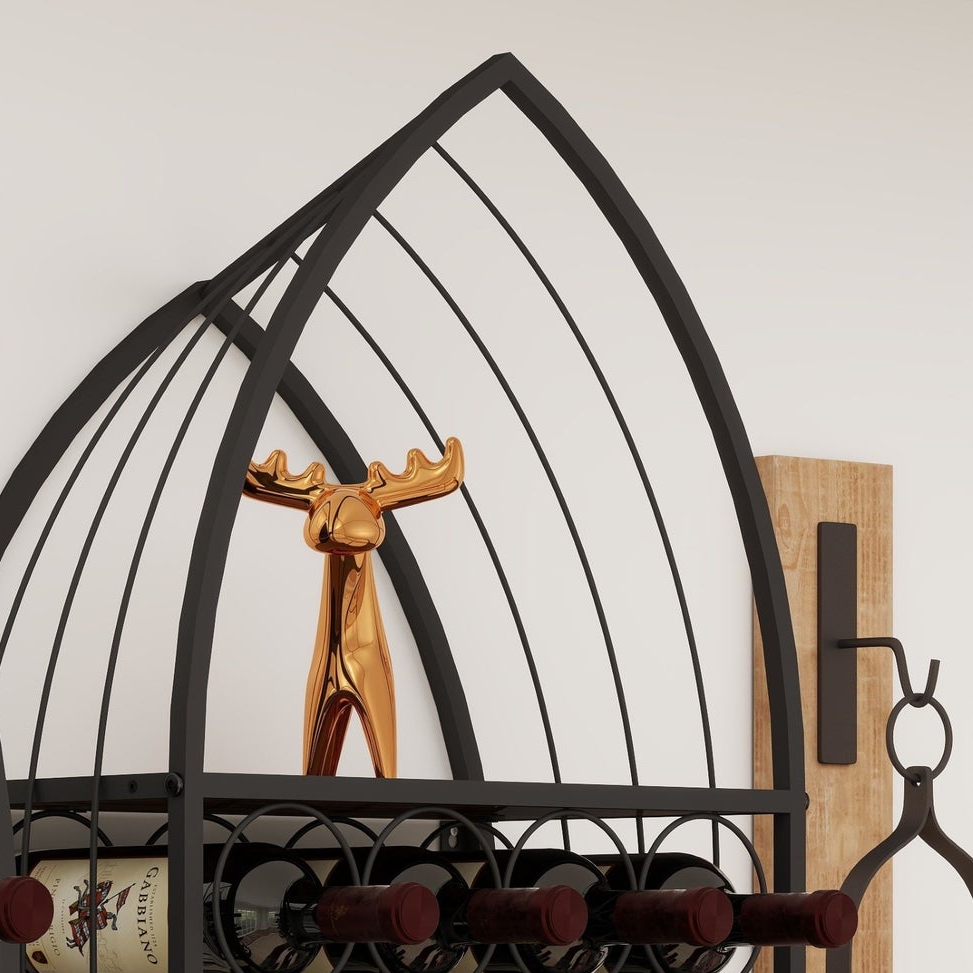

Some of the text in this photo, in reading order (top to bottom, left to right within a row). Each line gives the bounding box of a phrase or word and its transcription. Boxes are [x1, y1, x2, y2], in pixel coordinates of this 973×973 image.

[49, 878, 61, 957] PIN RIGIO
[137, 866, 160, 965] GABBIANO
